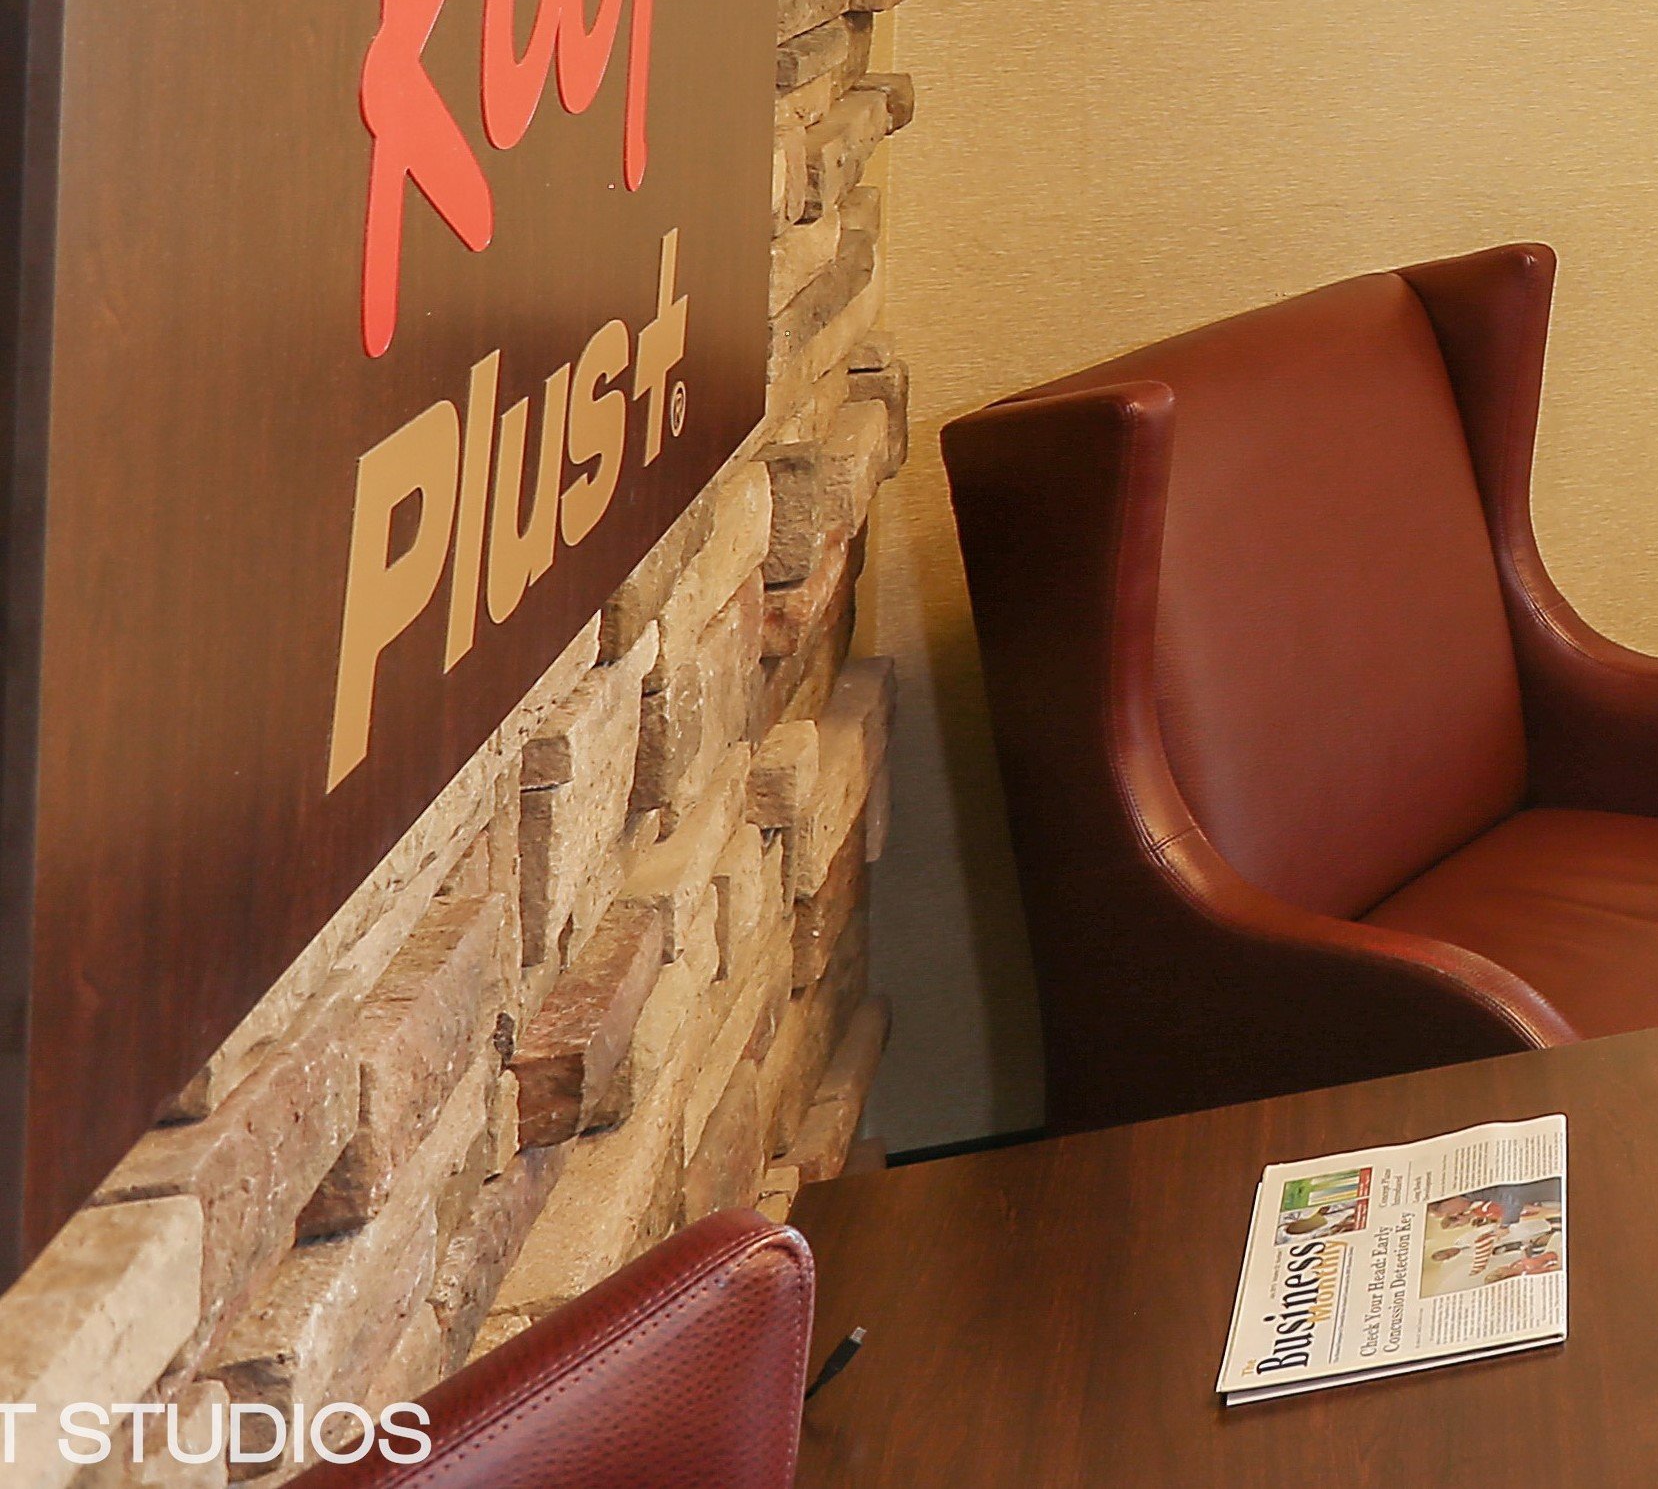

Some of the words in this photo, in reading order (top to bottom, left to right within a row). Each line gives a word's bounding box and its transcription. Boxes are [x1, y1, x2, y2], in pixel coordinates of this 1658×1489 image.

[1396, 1212, 1415, 1233] Key
[1372, 1226, 1393, 1257] Early
[1368, 1258, 1387, 1292] Head:
[1390, 1234, 1411, 1289] Detection
[1307, 1240, 1348, 1322] Monthly
[1256, 1241, 1326, 1375] Business
[1365, 1294, 1383, 1322] Your
[1383, 1289, 1405, 1353] Concussion
[1360, 1322, 1380, 1357] Check
[1241, 1359, 1256, 1376] The
